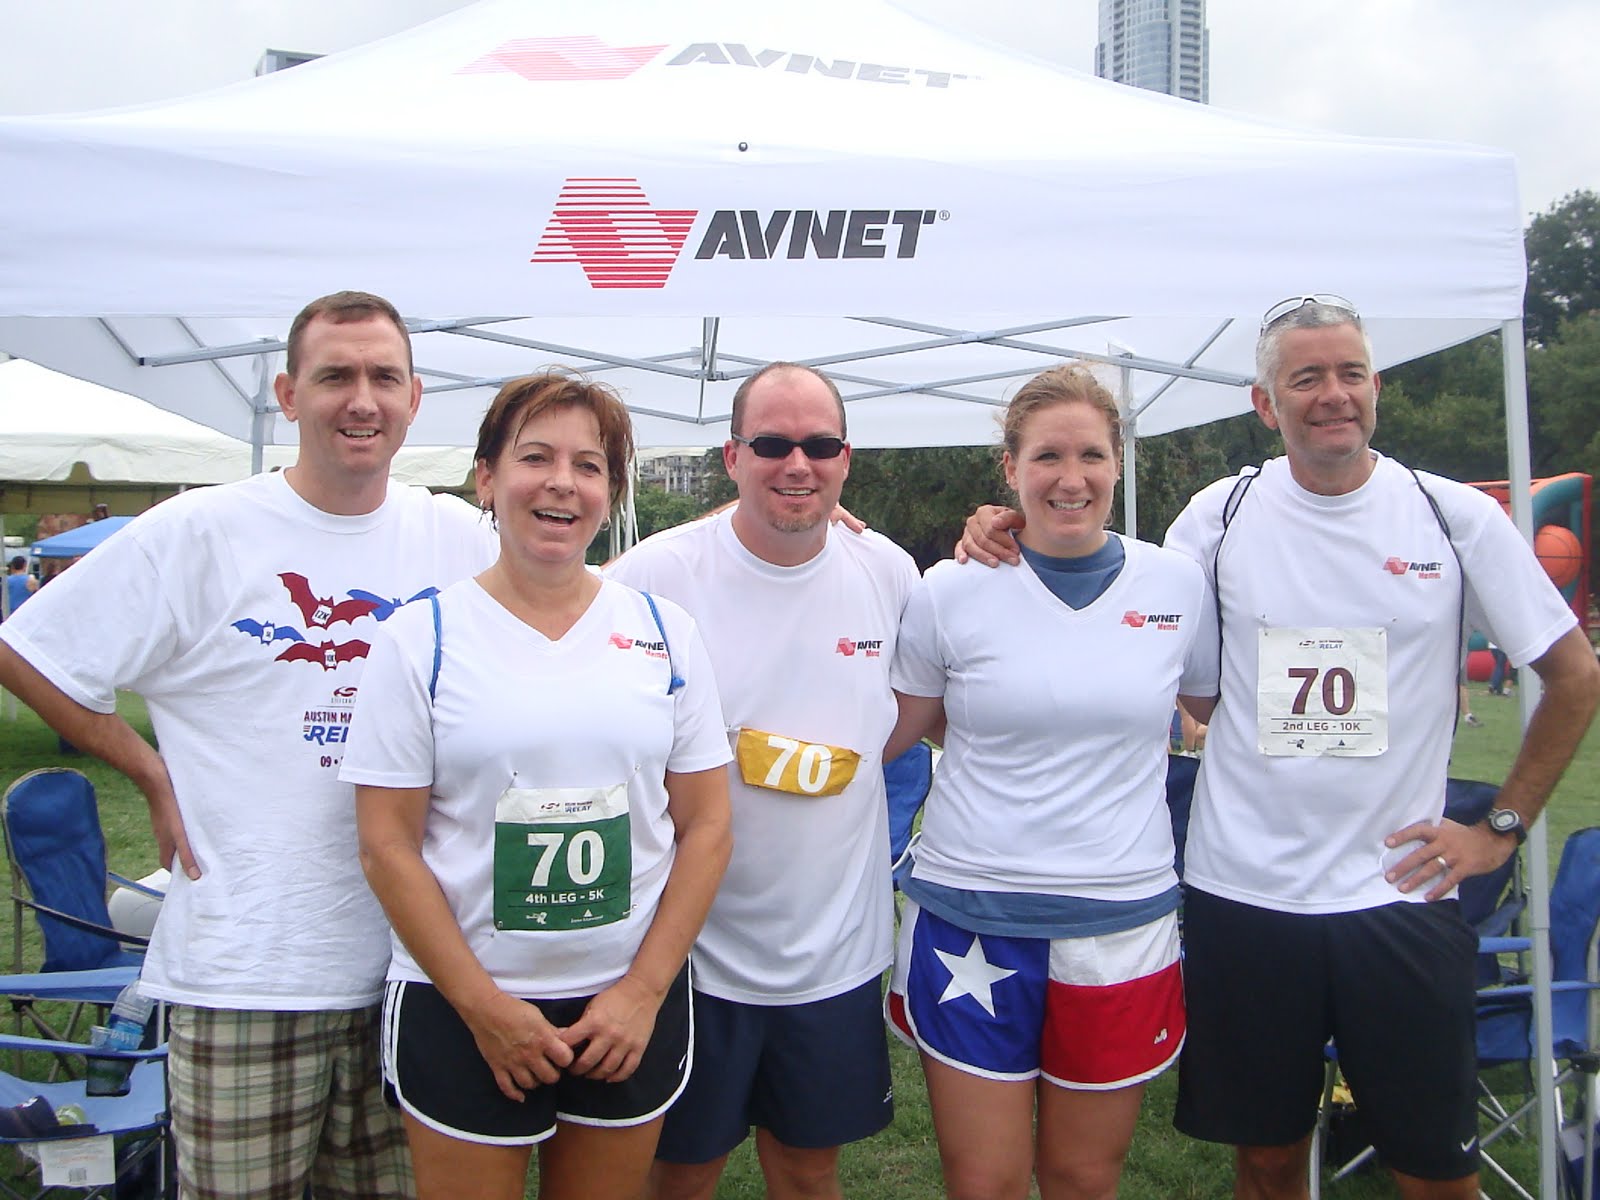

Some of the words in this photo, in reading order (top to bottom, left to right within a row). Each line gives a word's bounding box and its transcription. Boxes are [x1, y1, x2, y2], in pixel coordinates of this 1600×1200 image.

[666, 42, 967, 89] AVNET
[314, 609, 330, 620] 12K
[1147, 614, 1183, 623] AVNET
[634, 639, 665, 651] AVNE
[1288, 667, 1355, 715] 70
[303, 710, 337, 723] AUSTIN
[1282, 721, 1303, 731] 2nd
[1306, 722, 1329, 731] LEG
[1341, 722, 1361, 731] 10K
[320, 755, 332, 768] 09
[764, 735, 832, 793] 70
[527, 829, 605, 887] 70
[525, 893, 547, 904] 4th
[551, 892, 577, 904] LEG
[588, 888, 605, 900] 5K
